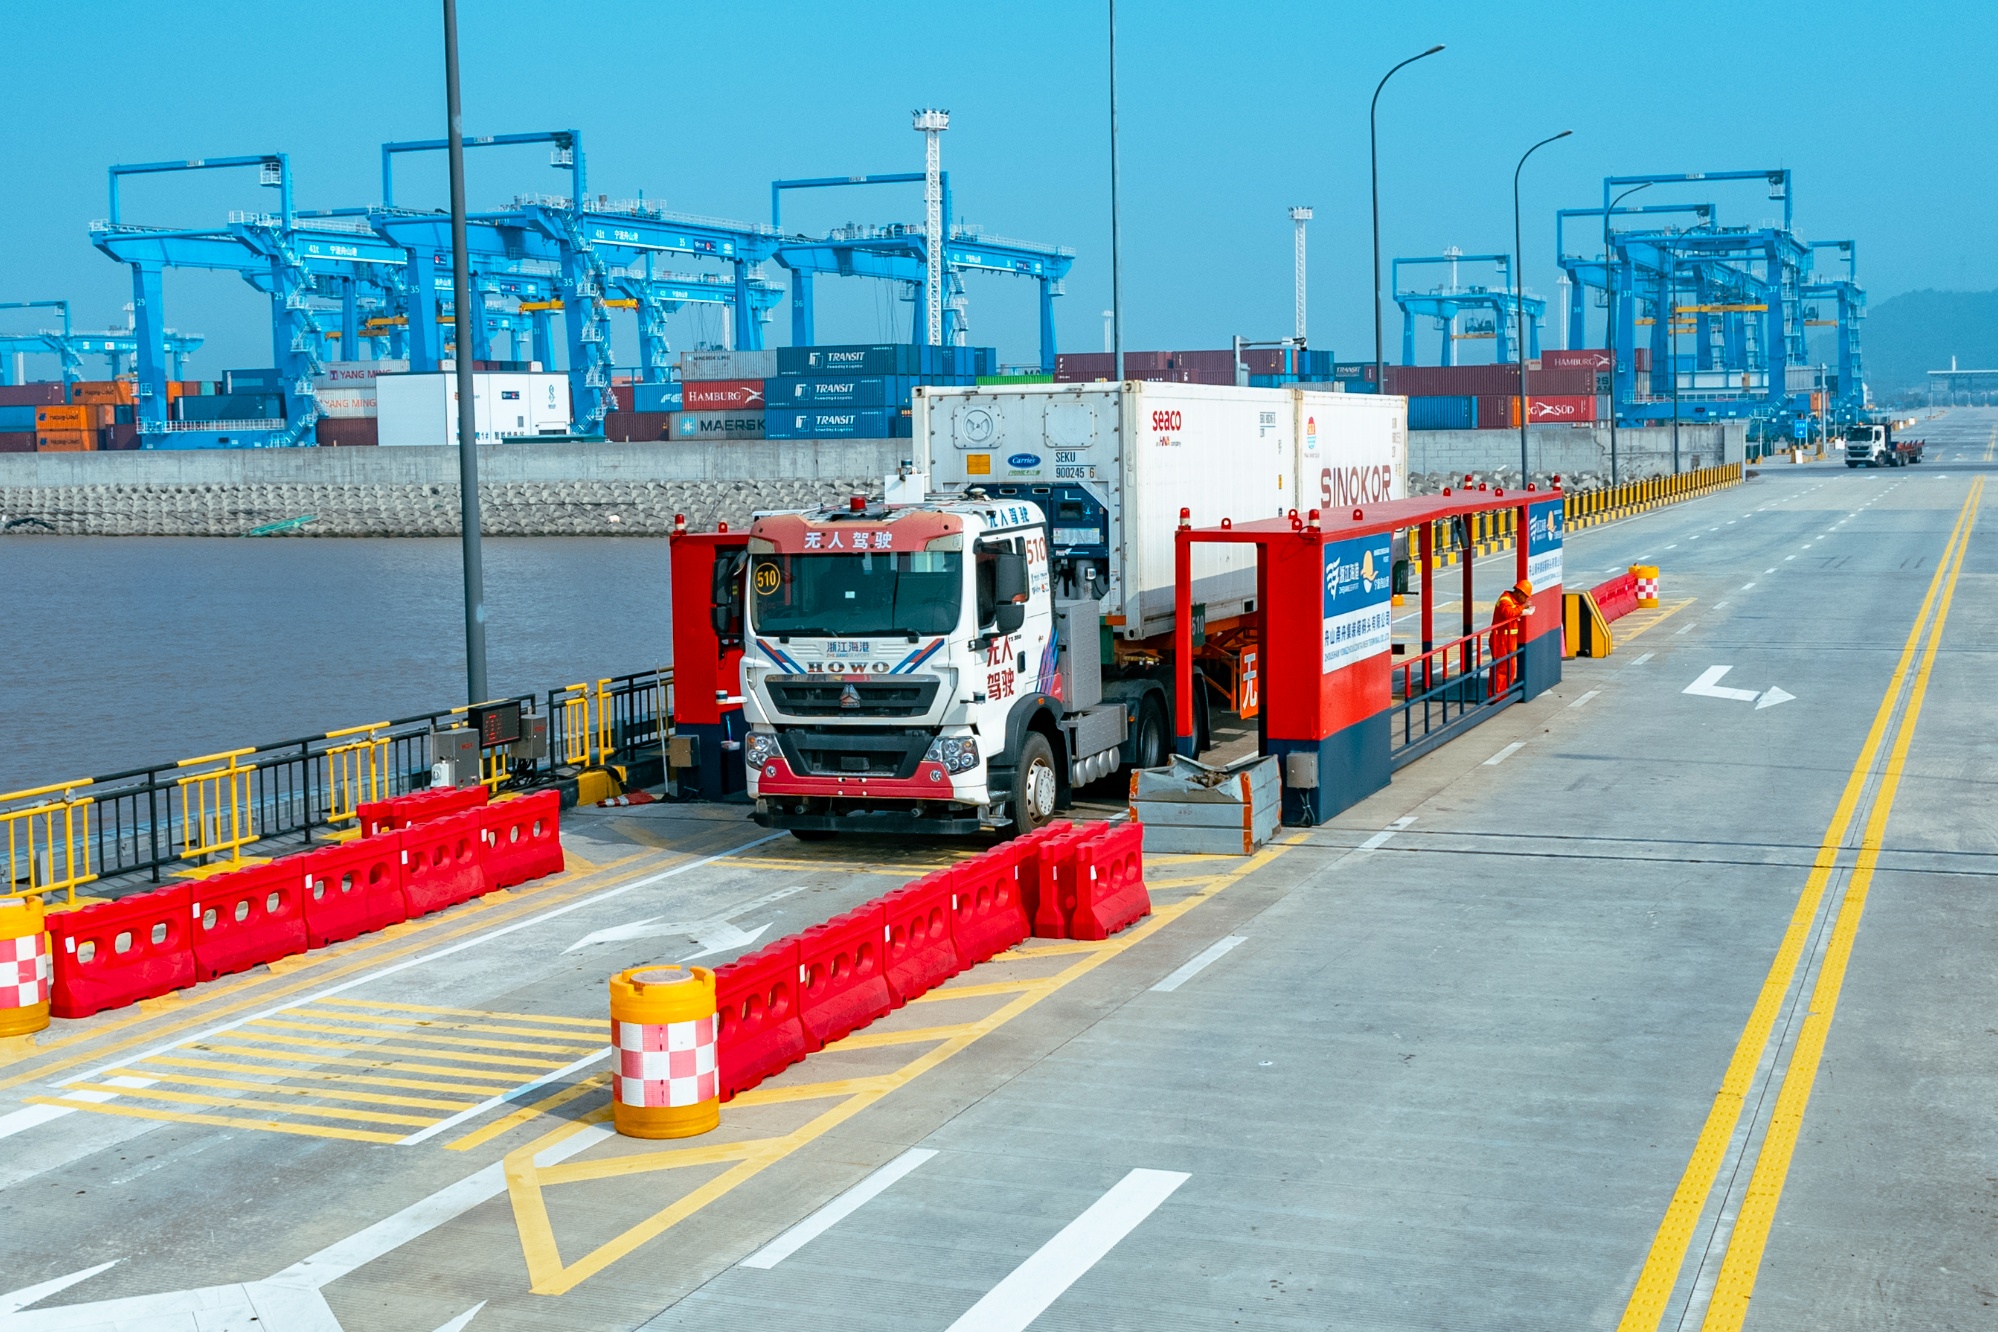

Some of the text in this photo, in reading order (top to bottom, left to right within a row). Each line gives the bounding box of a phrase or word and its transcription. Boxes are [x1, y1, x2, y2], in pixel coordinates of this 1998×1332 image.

[564, 278, 573, 287] 35
[410, 285, 420, 294] 35
[1622, 290, 1631, 298] 37
[275, 292, 283, 300] 29
[137, 298, 145, 306] 29
[828, 352, 865, 361] TRANSIT
[1554, 357, 1595, 366] HAMBURG
[340, 370, 364, 379] YANG
[815, 383, 854, 393] TRANSIT
[689, 391, 741, 401] HAMBURG
[352, 399, 376, 408] MING
[1555, 405, 1574, 415] SÜD
[700, 419, 766, 431] MAERSK
[815, 415, 855, 424] TRANSIT
[1152, 410, 1181, 431] seaco
[1055, 451, 1075, 463] SEKU
[1056, 467, 1095, 478] 900245 6
[1320, 464, 1391, 509] SINOKOR
[804, 531, 892, 550] 无人驾驶
[1026, 536, 1046, 565] 510
[757, 570, 776, 587] 510
[1339, 562, 1359, 584] 浙江海港
[1192, 614, 1205, 636] 510
[826, 641, 869, 652] 浙江海港
[987, 635, 1013, 667] 无人
[807, 661, 890, 673] HOWO
[987, 668, 1014, 701] 驾驶
[1242, 653, 1257, 710] 无
